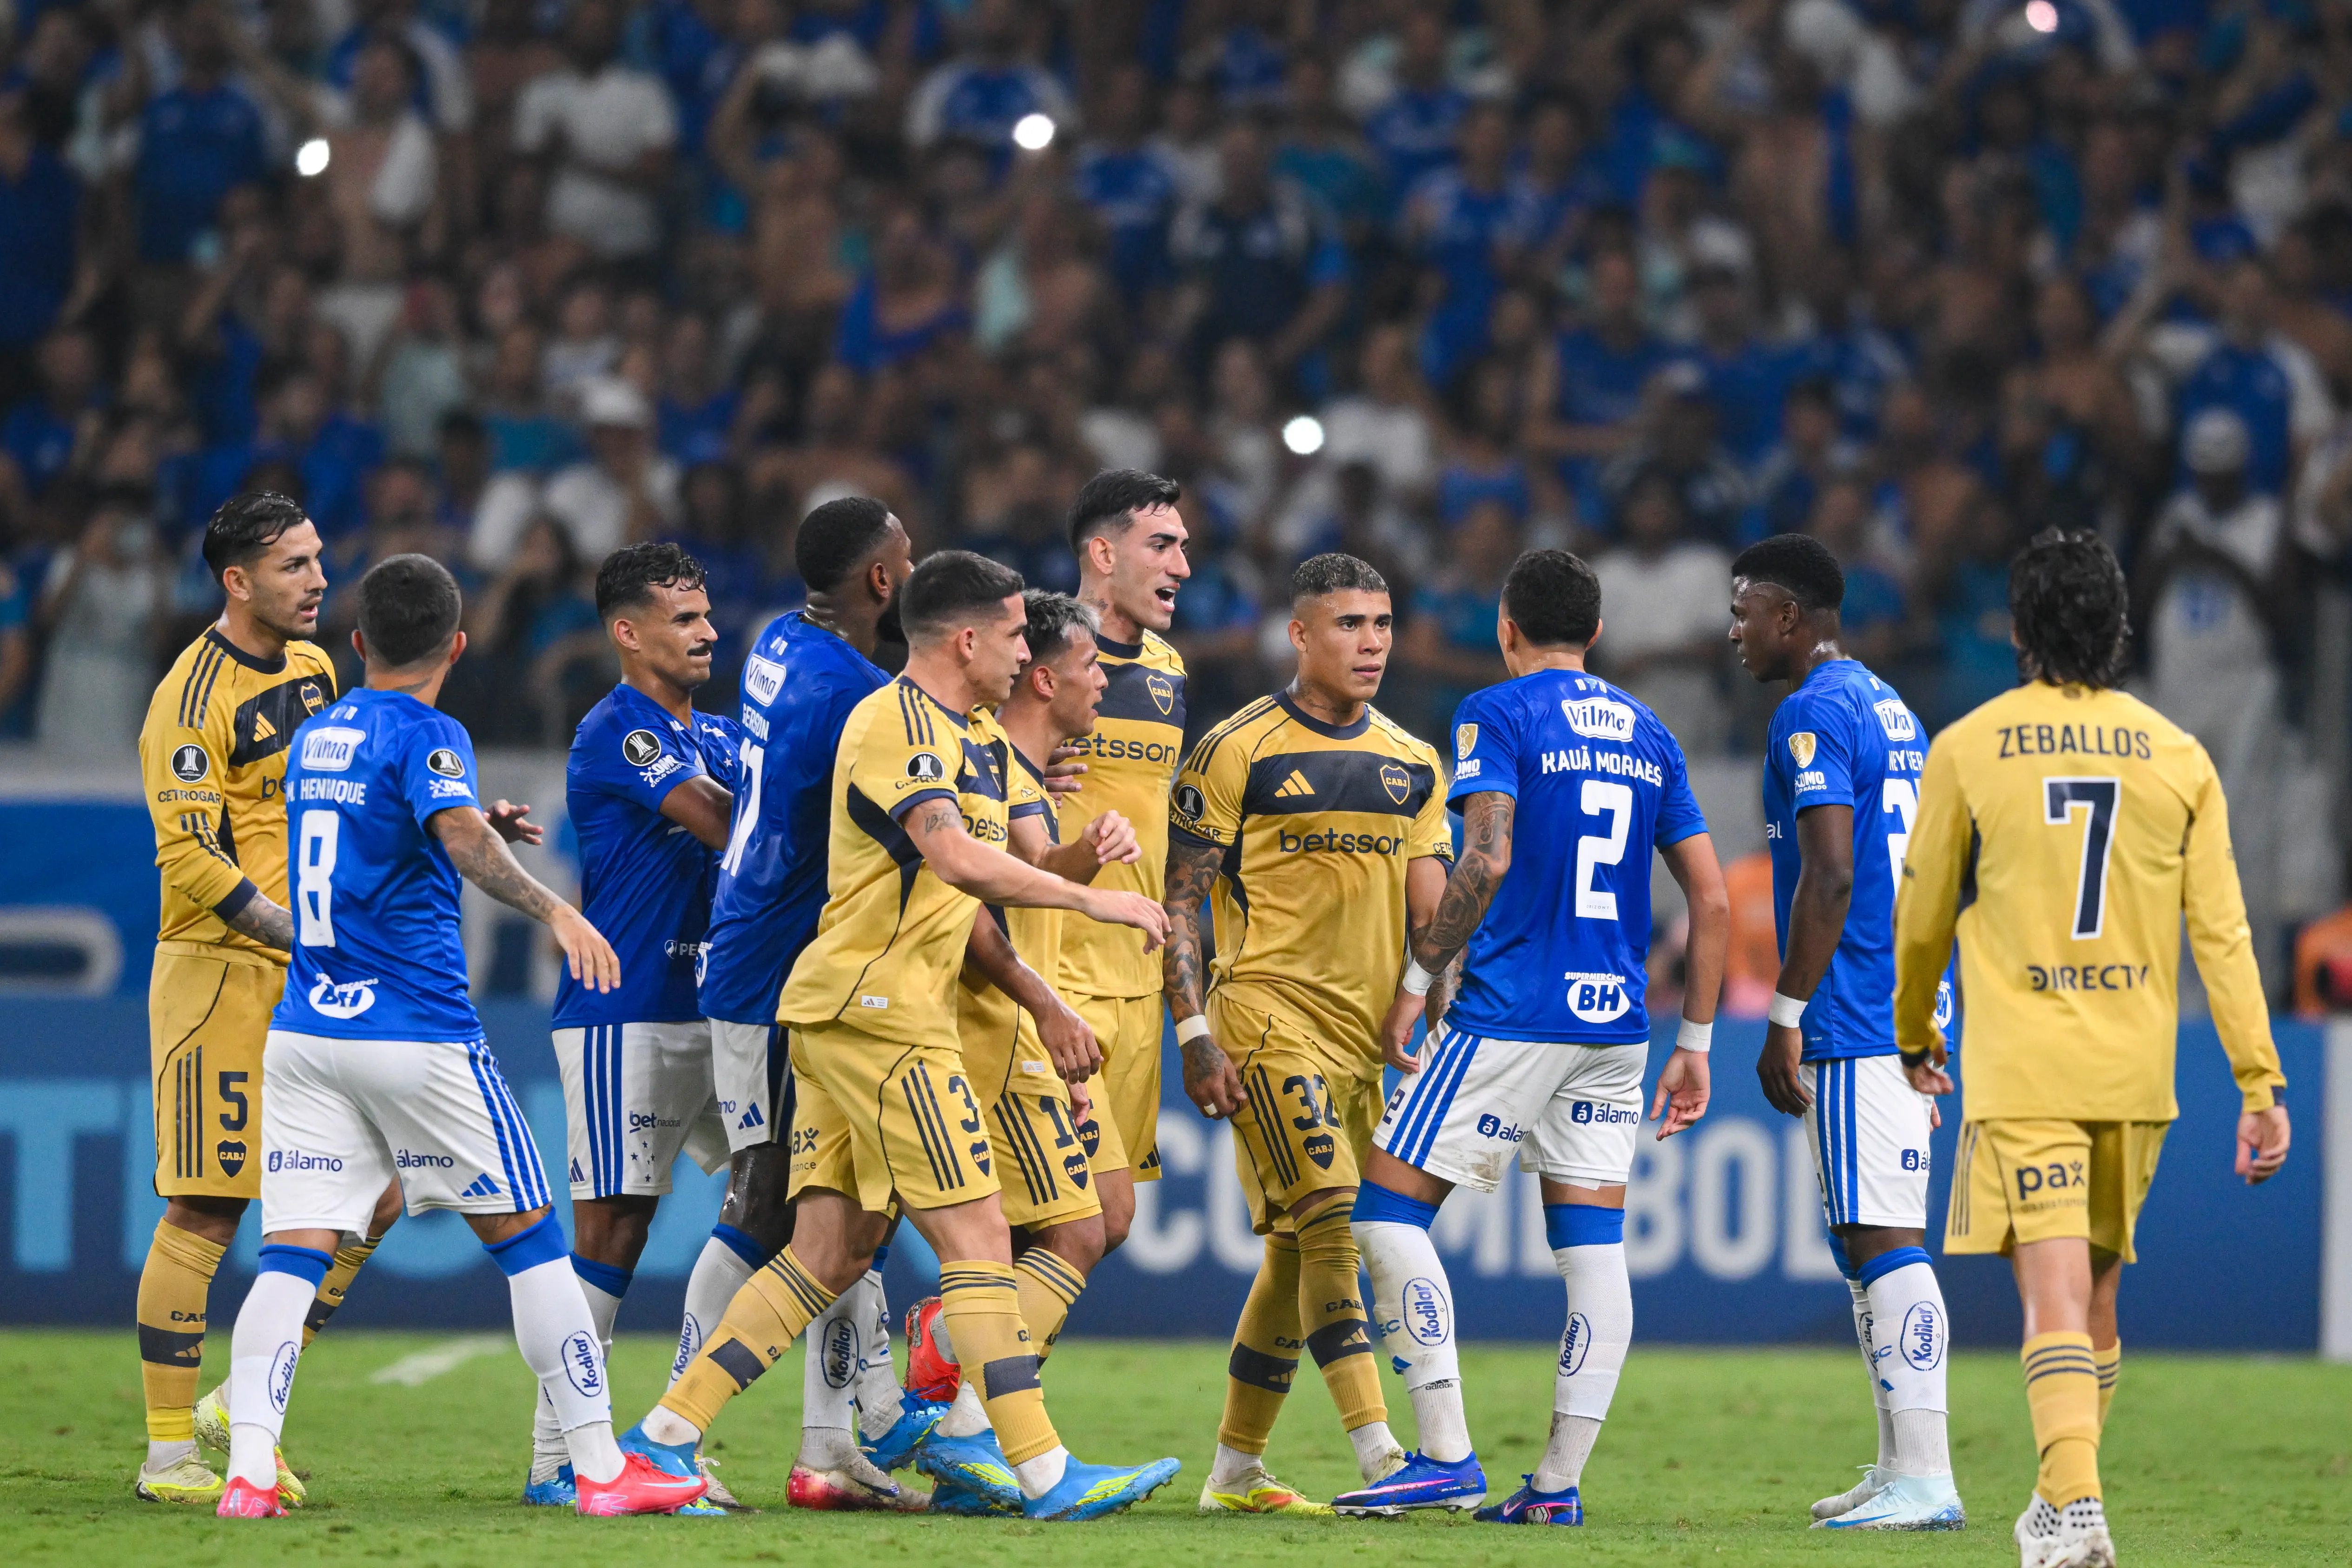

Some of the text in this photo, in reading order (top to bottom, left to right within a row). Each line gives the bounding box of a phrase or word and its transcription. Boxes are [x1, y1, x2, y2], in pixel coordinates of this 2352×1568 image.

[749, 660, 776, 697] Vilma
[1152, 687, 1170, 698] CABJ
[306, 695, 322, 707] CABJ
[1568, 706, 1628, 732] Vilma
[742, 703, 770, 741] GERSON
[305, 736, 349, 761] Vilma
[1064, 732, 1176, 766] etsson
[1998, 724, 2151, 760] ZEBALLOS
[1386, 776, 1407, 787] CABJ
[1595, 751, 1662, 787] MORAES
[158, 789, 221, 805] CETROGAR
[1576, 780, 1632, 920] 2
[2042, 776, 2121, 941] 7
[298, 810, 339, 947] 8
[1577, 984, 1620, 1011] BH
[219, 1071, 248, 1131] 5
[948, 1075, 980, 1134] 3
[1282, 1074, 1341, 1131] 32
[1382, 1088, 1406, 1125] 2
[1594, 1103, 1638, 1125] álamo
[629, 1111, 657, 1129] bet
[1080, 1130, 1098, 1142] ABJ
[219, 1151, 245, 1162] CABJ
[284, 1150, 343, 1172] álamo
[396, 1149, 454, 1169] álamo
[1308, 1144, 1333, 1156] CABJ
[1068, 1163, 1087, 1176] CABJ
[2016, 1159, 2085, 1200] pax
[1414, 1284, 1442, 1338] Kodilar
[673, 1317, 693, 1373] Kodilar
[830, 1323, 851, 1382] Kodilar
[1559, 1317, 1580, 1370] Kodilar
[1912, 1307, 1934, 1363] Kodilar
[275, 1347, 299, 1408] Kodilar
[575, 1337, 600, 1389] Kodilar
[1425, 1382, 1453, 1390] adidas
